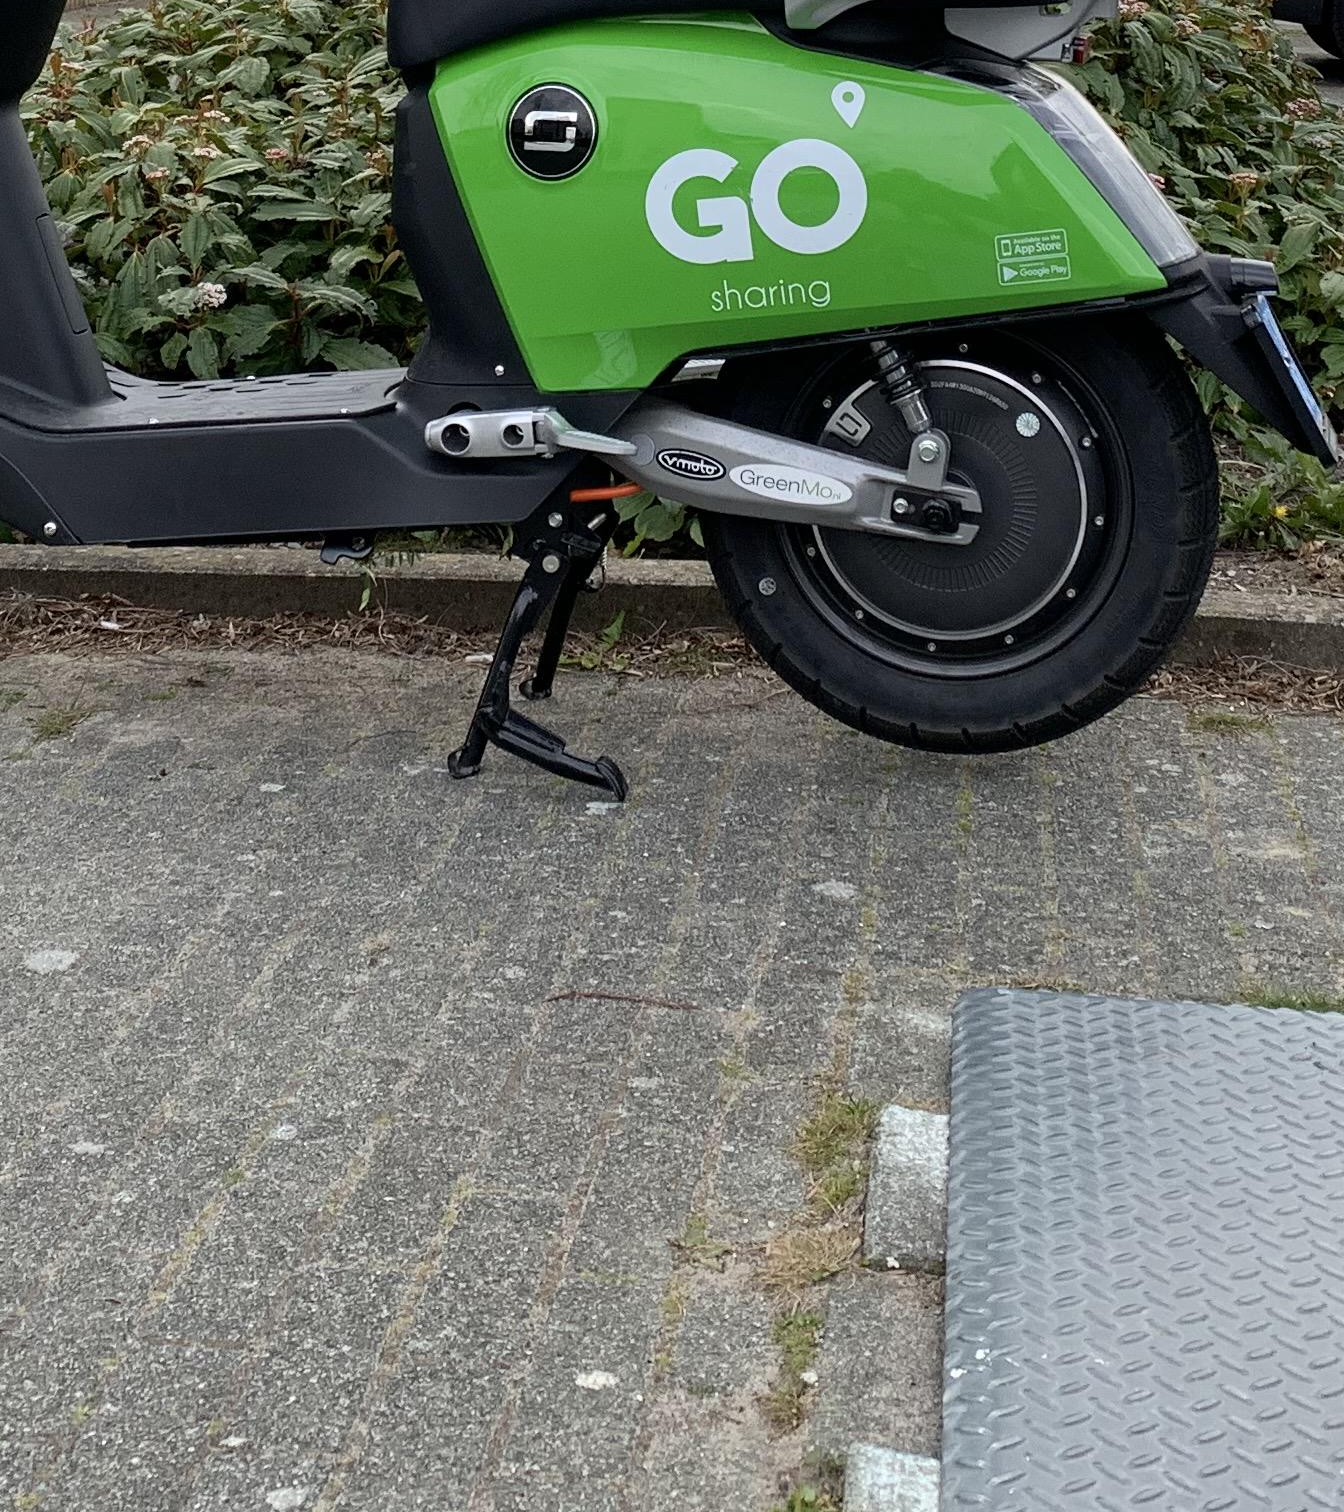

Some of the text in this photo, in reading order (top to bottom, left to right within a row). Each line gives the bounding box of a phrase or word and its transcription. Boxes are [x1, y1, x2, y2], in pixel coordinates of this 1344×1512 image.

[645, 138, 868, 265] GO
[1014, 241, 1062, 255] App Store
[1019, 267, 1050, 278] Google
[1050, 264, 1067, 275] Play
[711, 279, 831, 312] sharing
